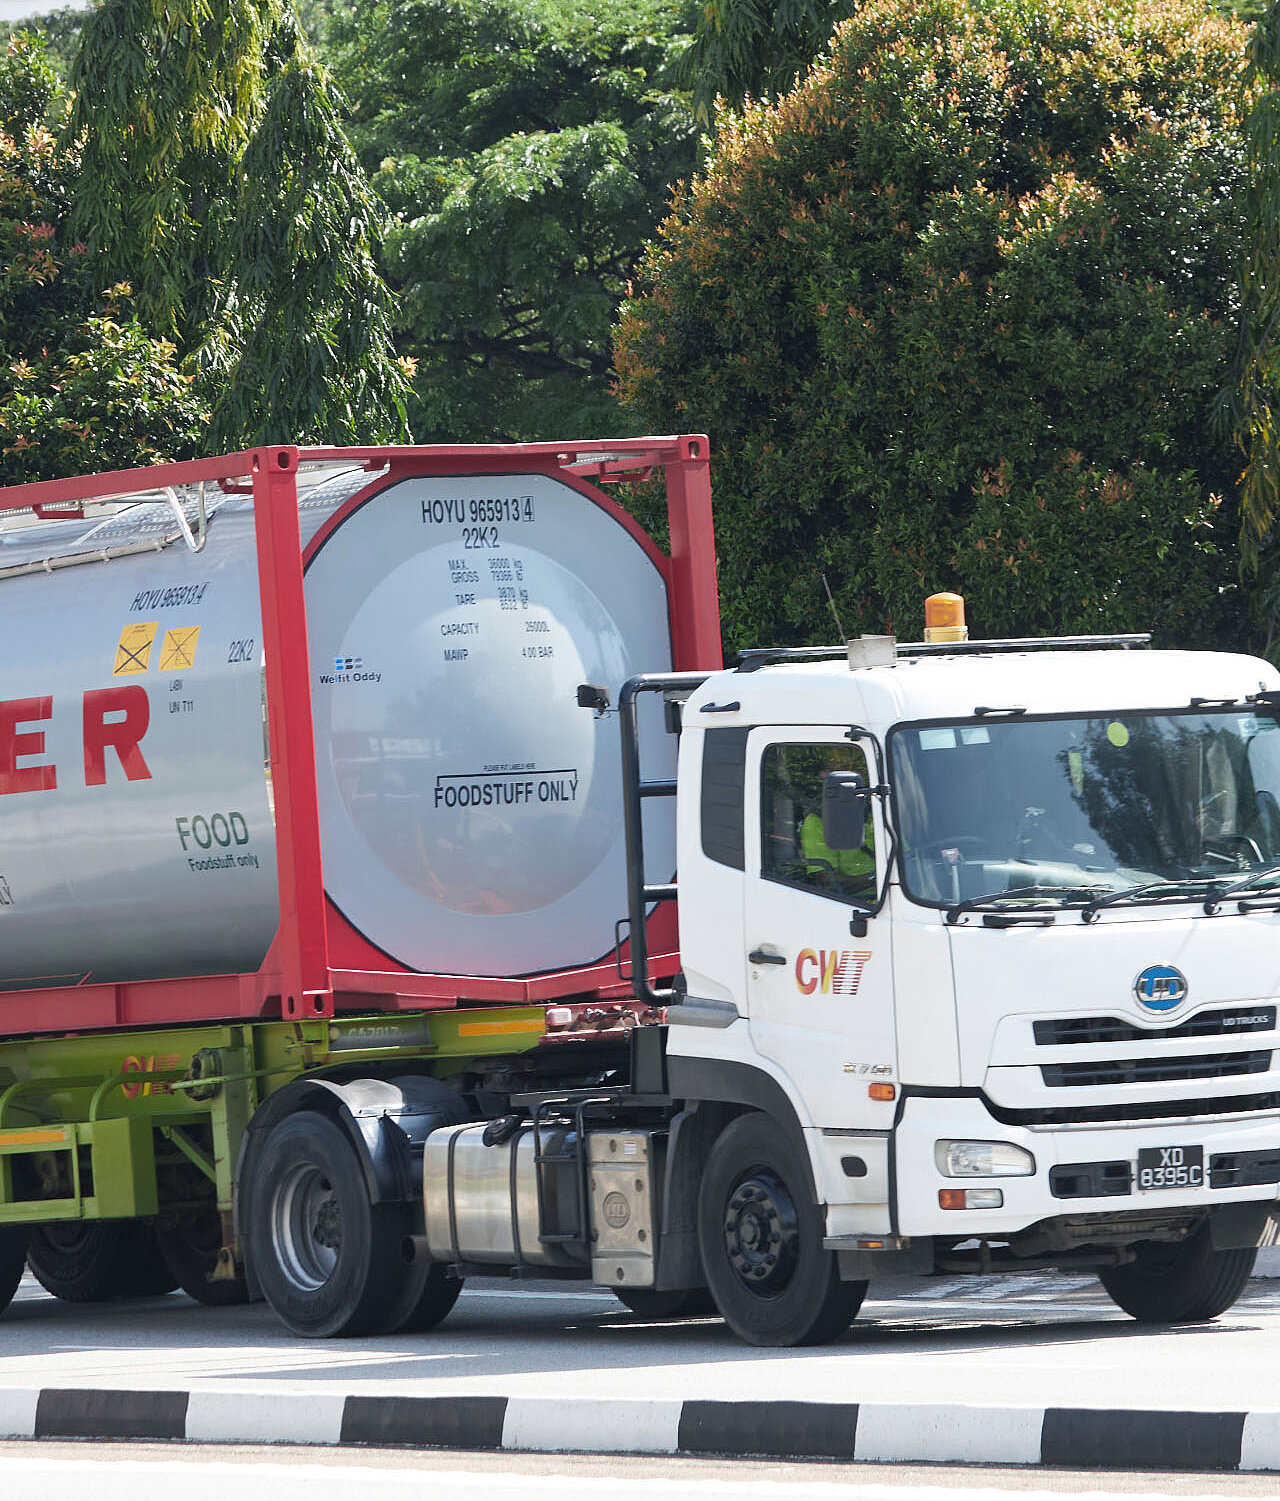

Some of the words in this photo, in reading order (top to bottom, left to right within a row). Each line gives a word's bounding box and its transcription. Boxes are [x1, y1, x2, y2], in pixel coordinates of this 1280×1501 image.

[422, 500, 465, 523] HOYU
[470, 498, 520, 522] 965913
[462, 526, 500, 549] 22K2
[451, 571, 480, 583] GROSS
[129, 588, 166, 612] HOYU
[455, 593, 476, 605] TARE
[440, 622, 480, 636] CAPACITY
[227, 639, 254, 663] 22K2
[320, 674, 351, 684] Welfit
[353, 672, 381, 683] Oddy
[434, 782, 534, 809] FOODSTUFF
[538, 780, 579, 802] ONLY
[175, 811, 249, 851] FOOD
[188, 854, 236, 872] Foodstuff
[237, 853, 259, 869] only
[795, 948, 872, 995] CWT
[1136, 977, 1186, 1001] UD
[1223, 1017, 1235, 1026] UD
[1236, 1014, 1269, 1025] TRUCKS
[1160, 1148, 1184, 1167] XD
[1141, 1165, 1202, 1187] 8395C
